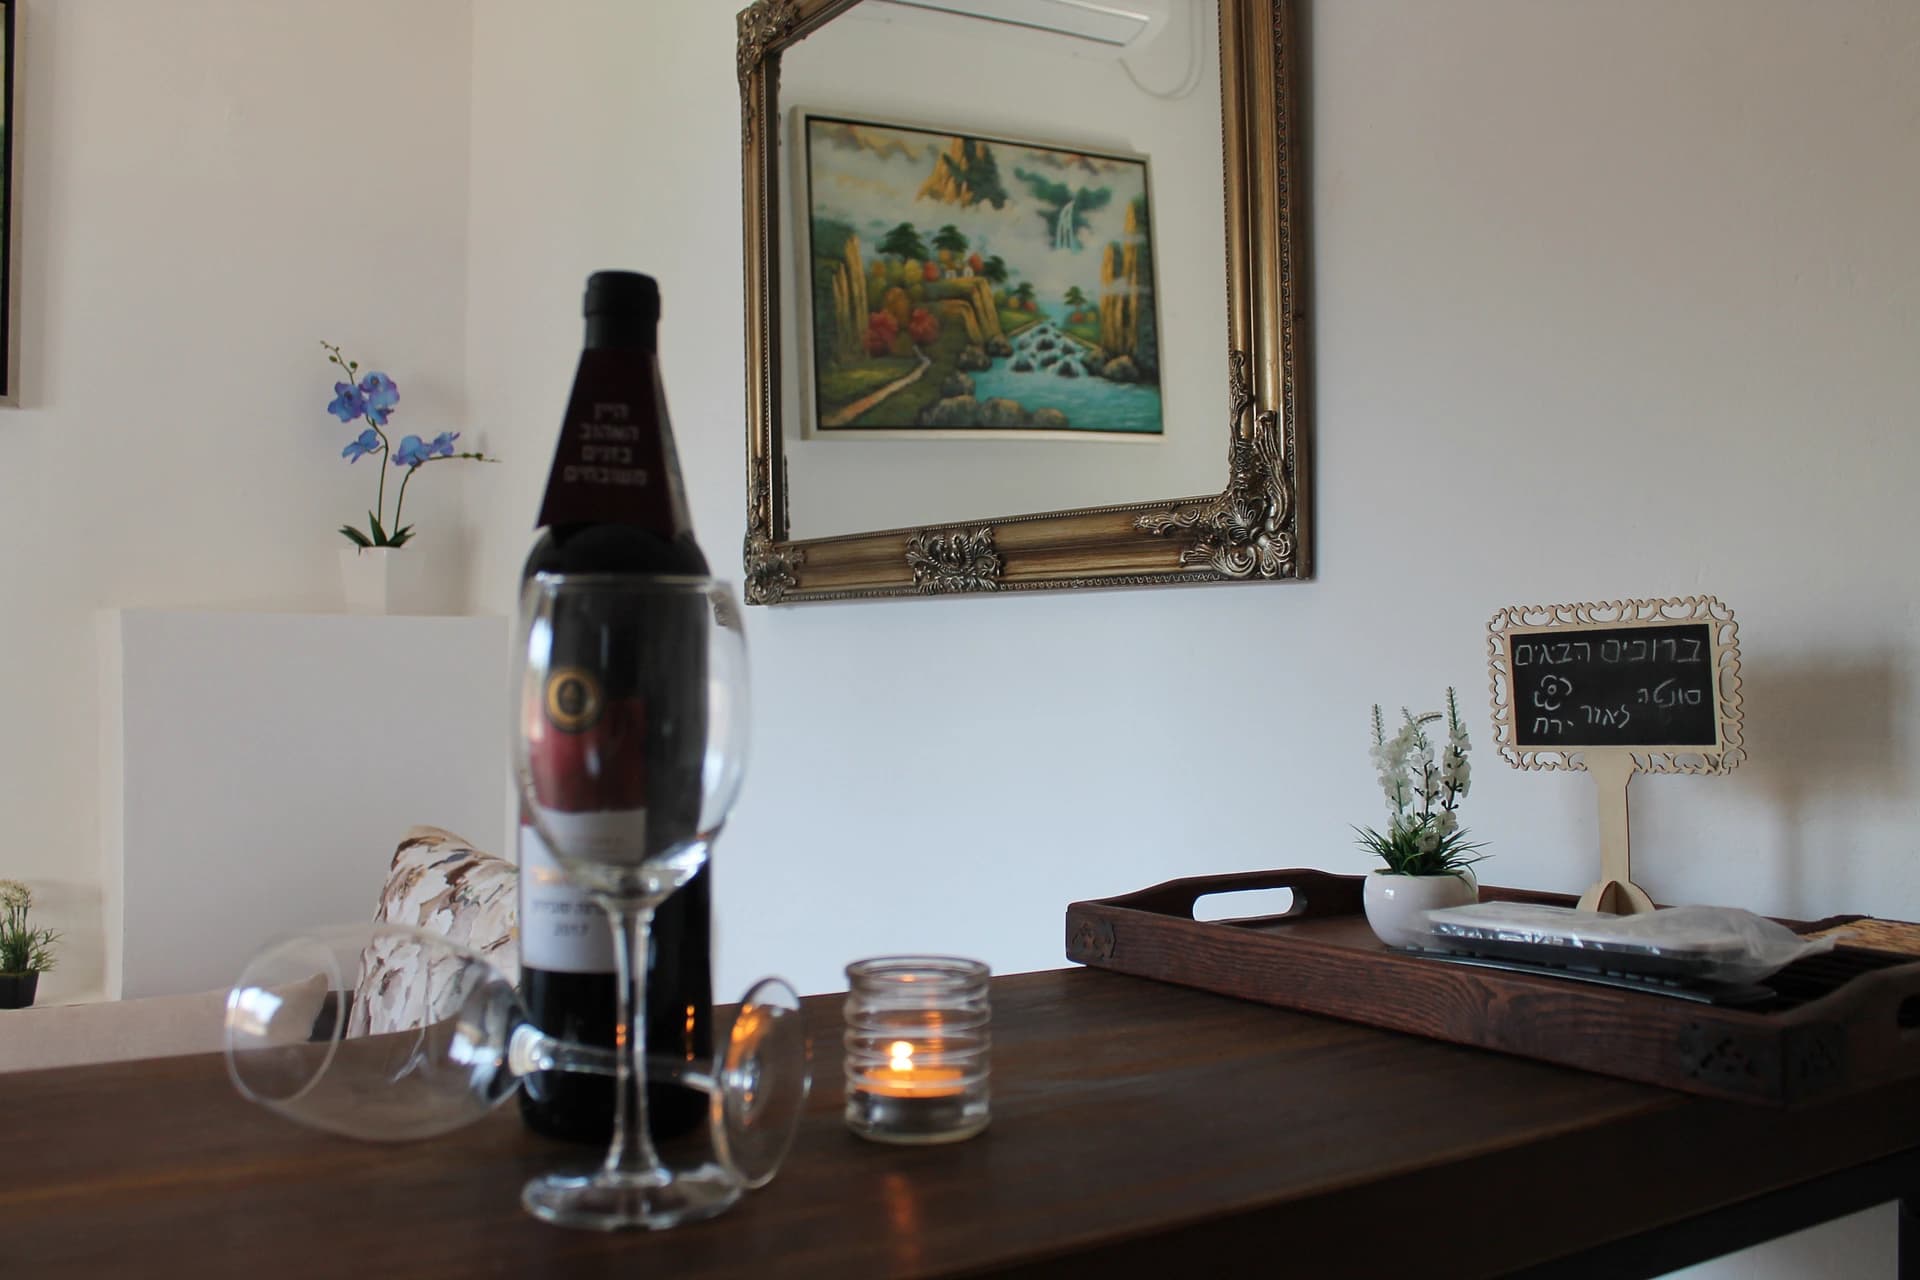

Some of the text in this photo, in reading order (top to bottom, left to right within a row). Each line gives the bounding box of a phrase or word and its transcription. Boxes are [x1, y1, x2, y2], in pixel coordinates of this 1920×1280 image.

[593, 403, 629, 420] היין
[1515, 638, 1701, 666] ברוכים הבאים
[1637, 678, 1701, 708] סונטה
[1533, 704, 1630, 734] לאור ירח
